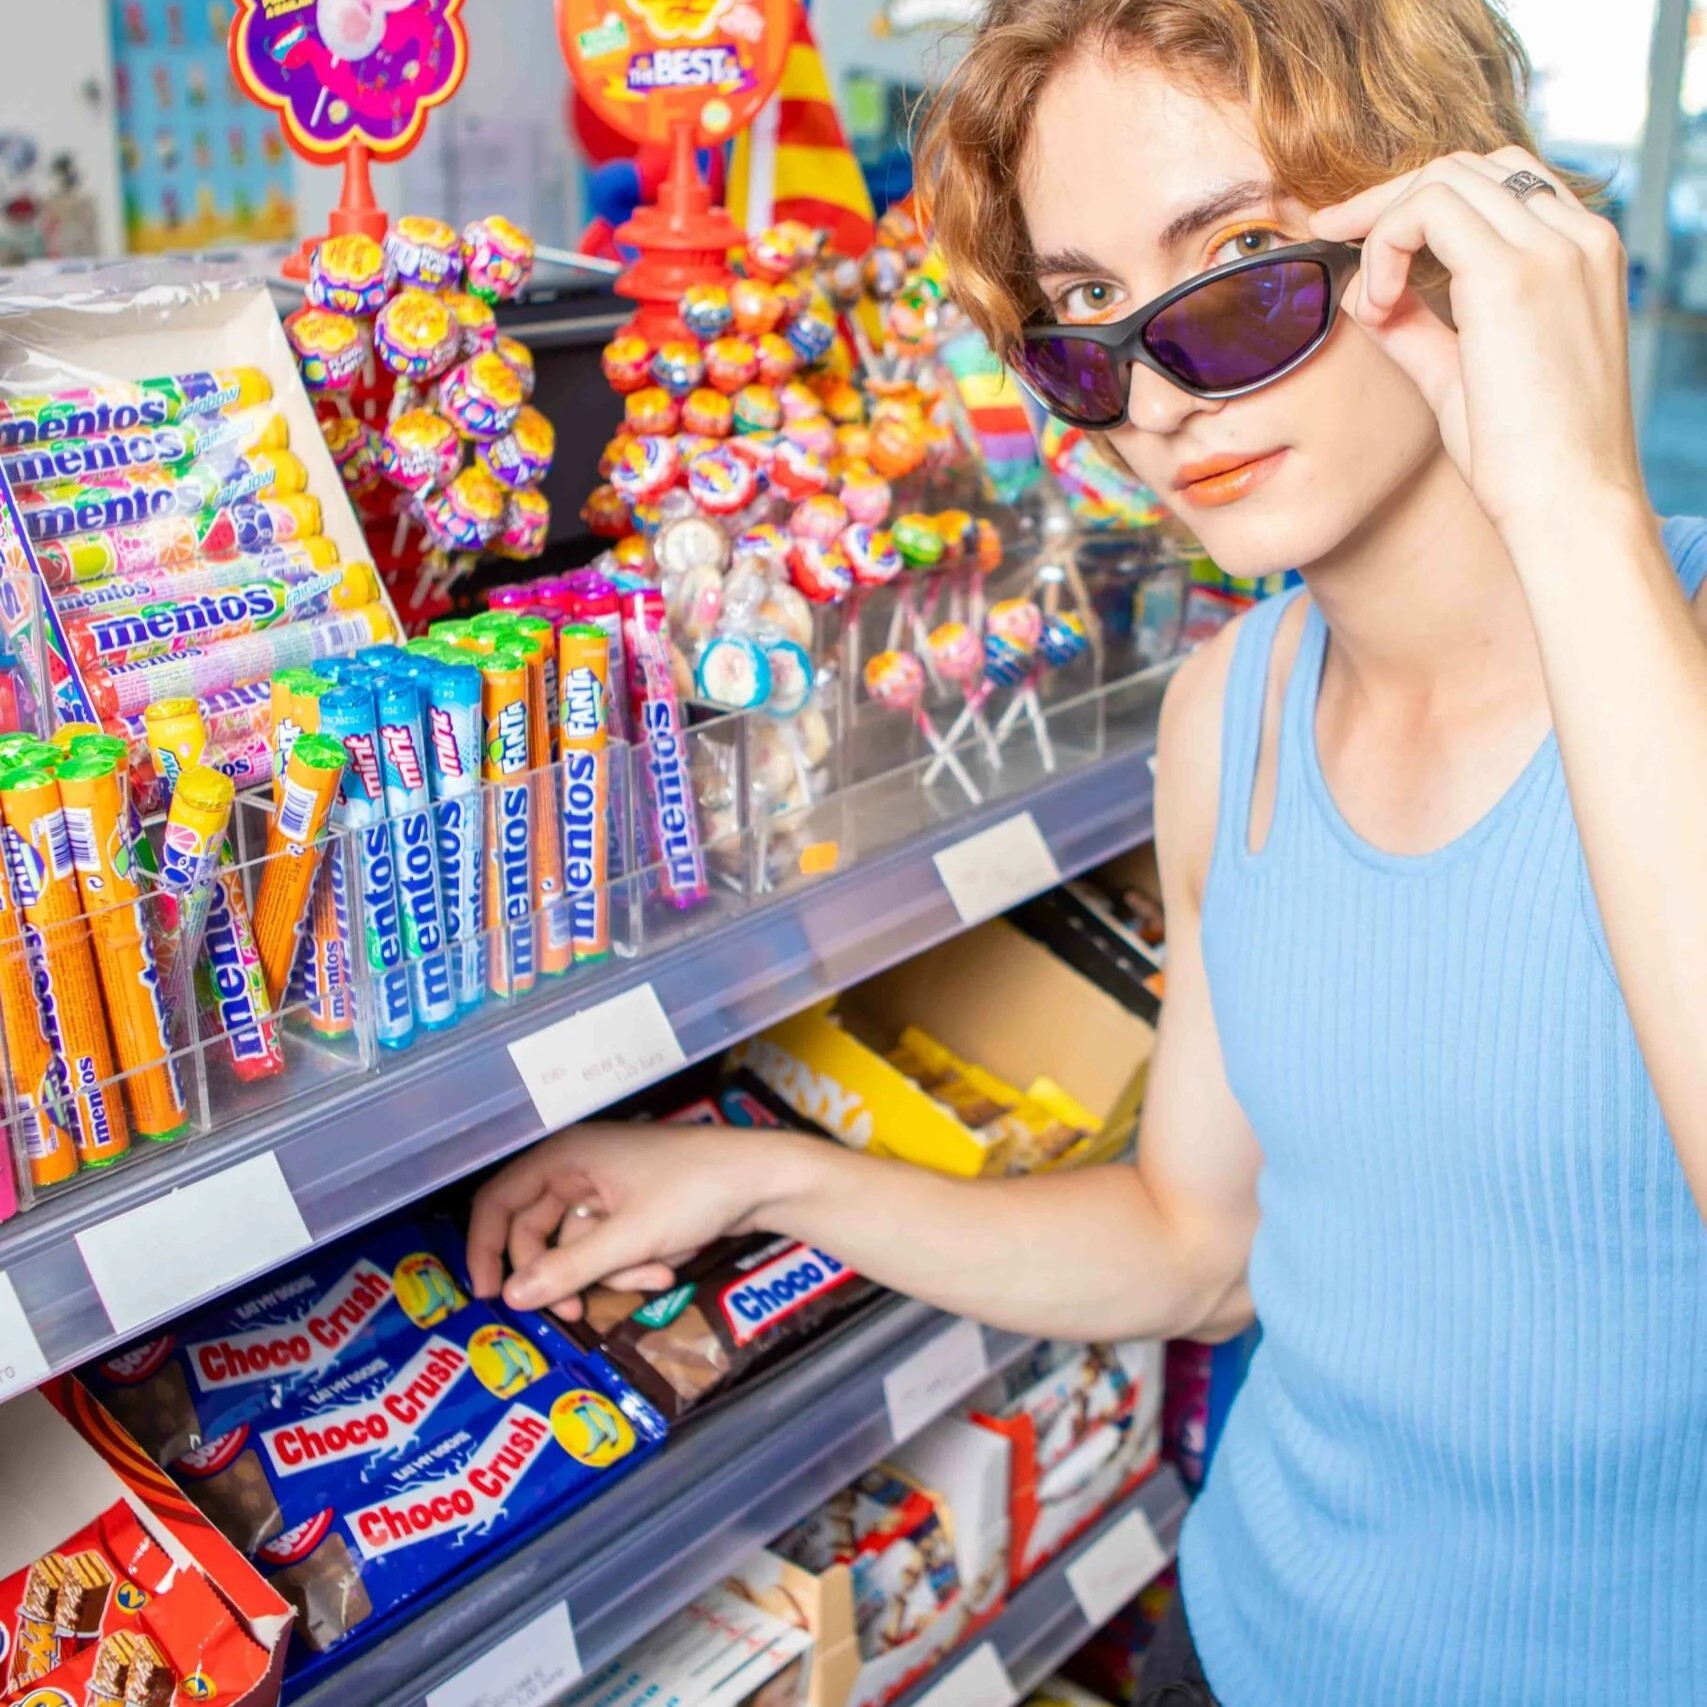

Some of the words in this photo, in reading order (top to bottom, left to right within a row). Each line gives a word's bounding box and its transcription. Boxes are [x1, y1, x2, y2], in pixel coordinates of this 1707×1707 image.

[653, 49, 727, 85] BEST
[0, 399, 166, 447] mentos
[2, 430, 185, 483] mentos
[56, 580, 150, 612] mentos
[92, 587, 275, 652] mentos
[499, 701, 527, 775] FANTA
[567, 667, 596, 739] FANTA
[380, 724, 423, 789] mint
[643, 701, 697, 888] mentos
[503, 784, 533, 979] mentos
[563, 752, 596, 940] mentos
[364, 822, 411, 1022] mentos
[402, 812, 451, 1007] mentos
[198, 1335, 311, 1382] Choco
[307, 1271, 390, 1350] Crush
[729, 1261, 824, 1322] Choco
[273, 1413, 389, 1465] Choco
[383, 1346, 464, 1424] Crush
[357, 1489, 474, 1547] Choco
[467, 1414, 548, 1498] Crush
